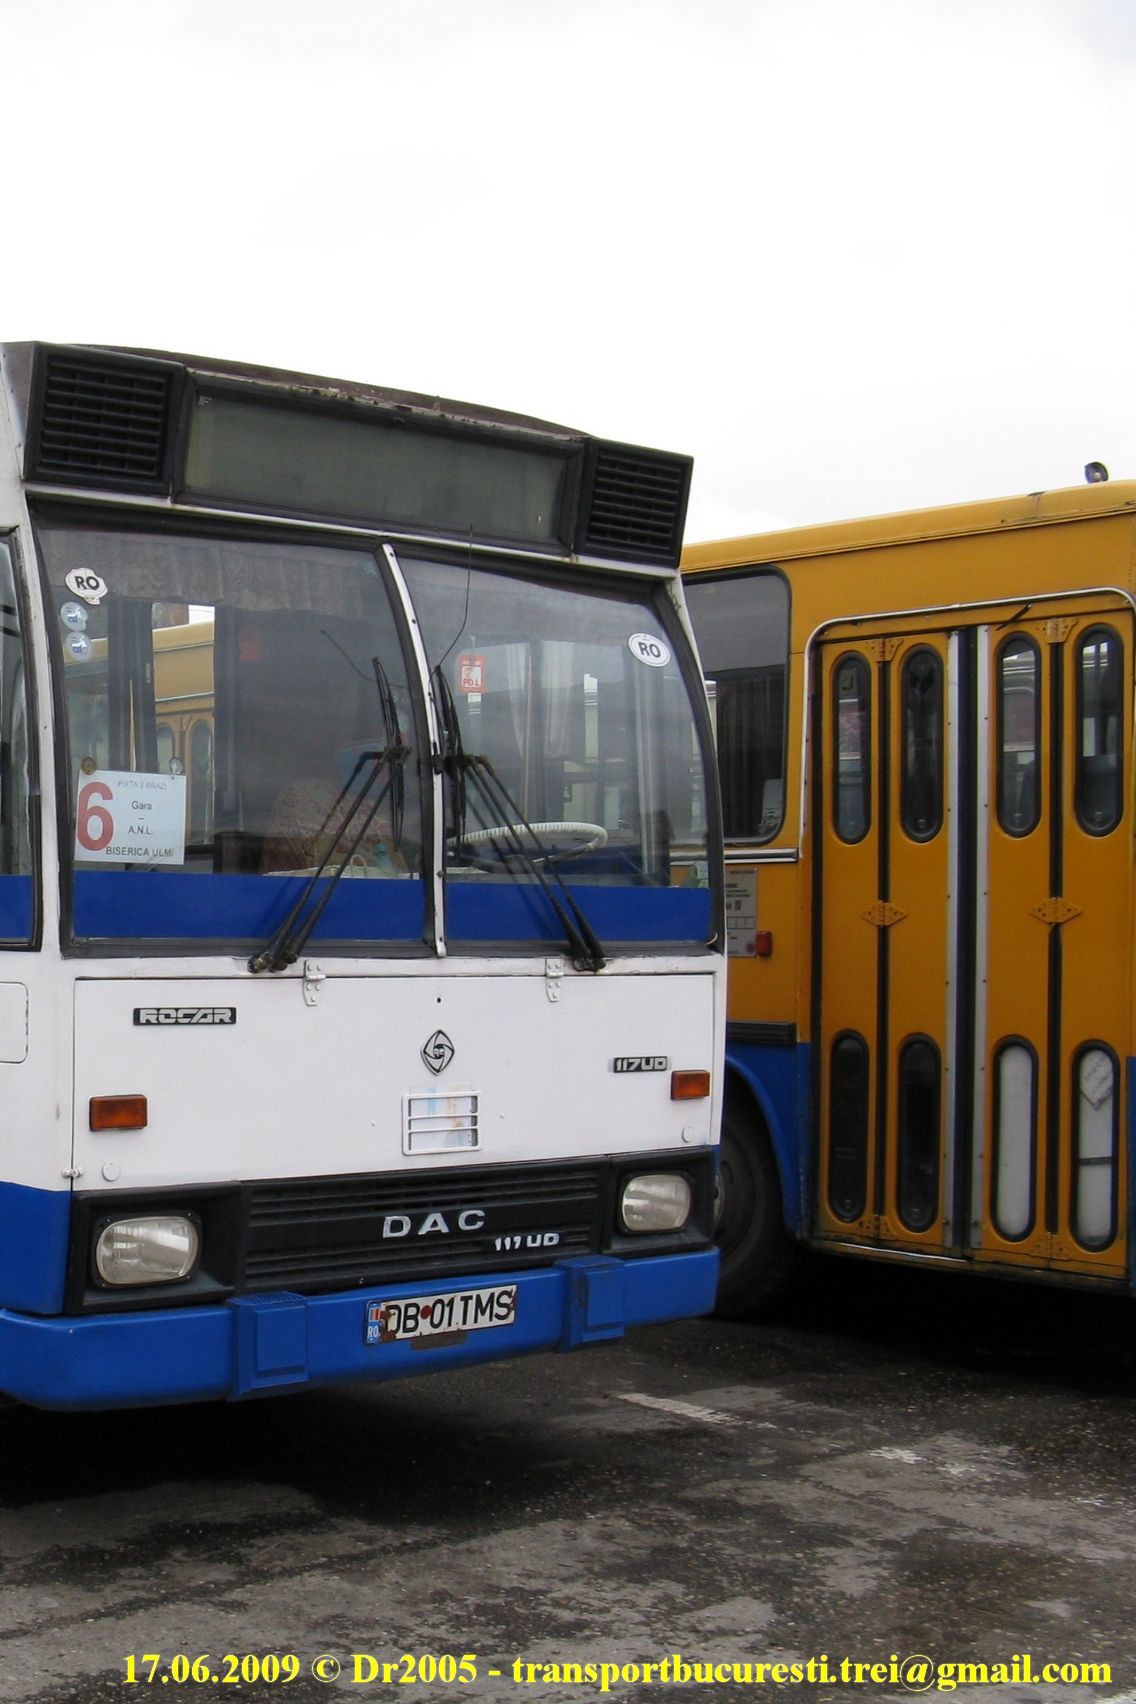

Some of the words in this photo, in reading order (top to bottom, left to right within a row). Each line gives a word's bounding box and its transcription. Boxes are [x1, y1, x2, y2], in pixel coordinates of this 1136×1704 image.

[74, 575, 100, 591] RO
[638, 641, 661, 659] RO
[131, 800, 153, 811] Gara
[77, 781, 115, 852] 6
[105, 847, 150, 857] BISERICA
[139, 1008, 233, 1024] ROCAR
[382, 1209, 486, 1239] DAC
[367, 1325, 379, 1338] RO
